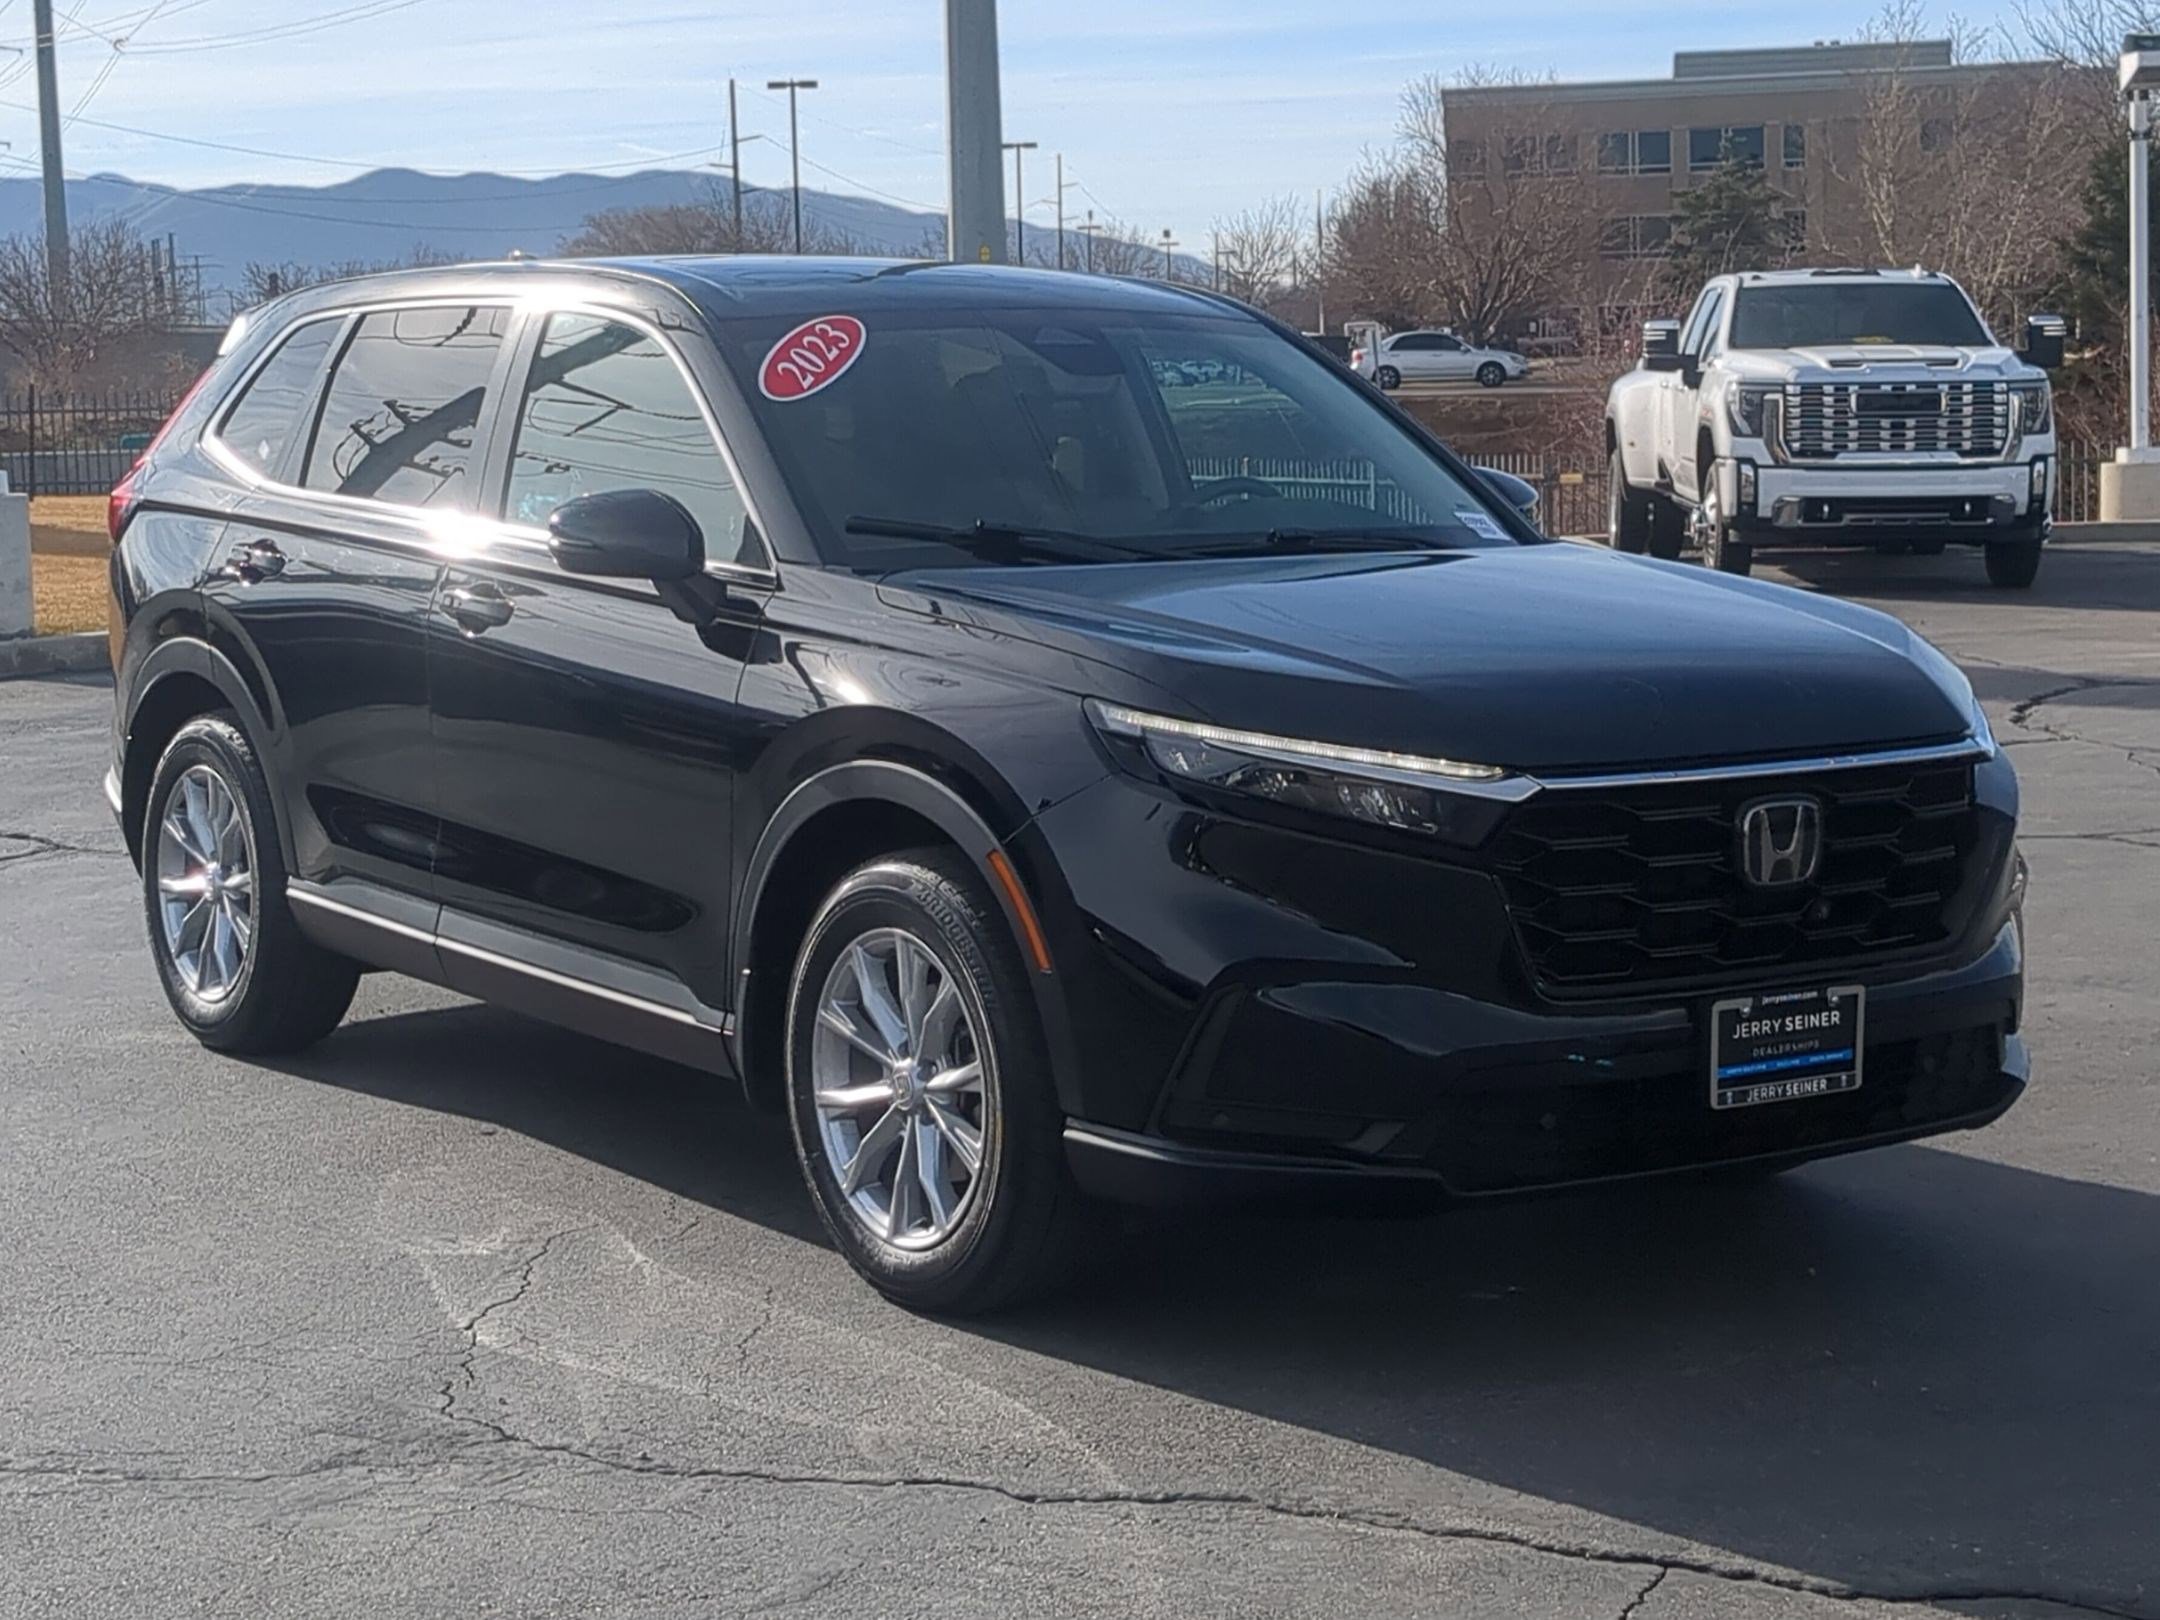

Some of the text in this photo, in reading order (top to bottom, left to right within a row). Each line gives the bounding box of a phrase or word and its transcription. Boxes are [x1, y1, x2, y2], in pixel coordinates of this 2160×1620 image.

[777, 323, 850, 390] 2023
[1732, 1010, 1841, 1039] JERRY SEINER
[1747, 1079, 1828, 1102] JERRY SEINER
